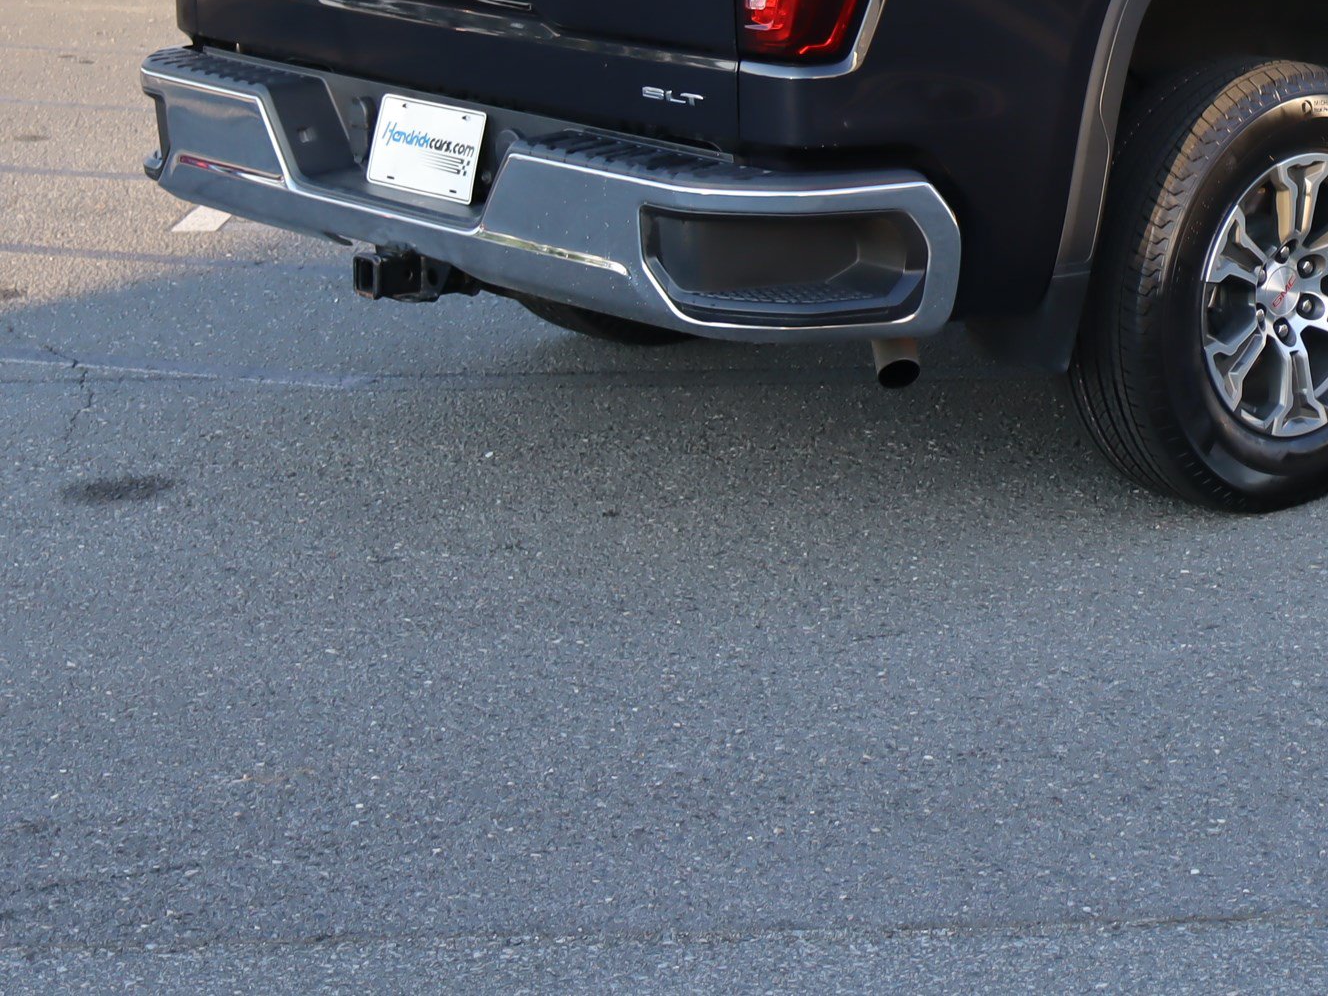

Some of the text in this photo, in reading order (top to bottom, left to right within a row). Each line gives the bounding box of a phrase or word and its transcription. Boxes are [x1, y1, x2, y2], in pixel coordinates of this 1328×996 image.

[641, 86, 704, 106] SLT
[382, 121, 475, 158] Hendrickcars.com
[1272, 272, 1298, 308] GMC
